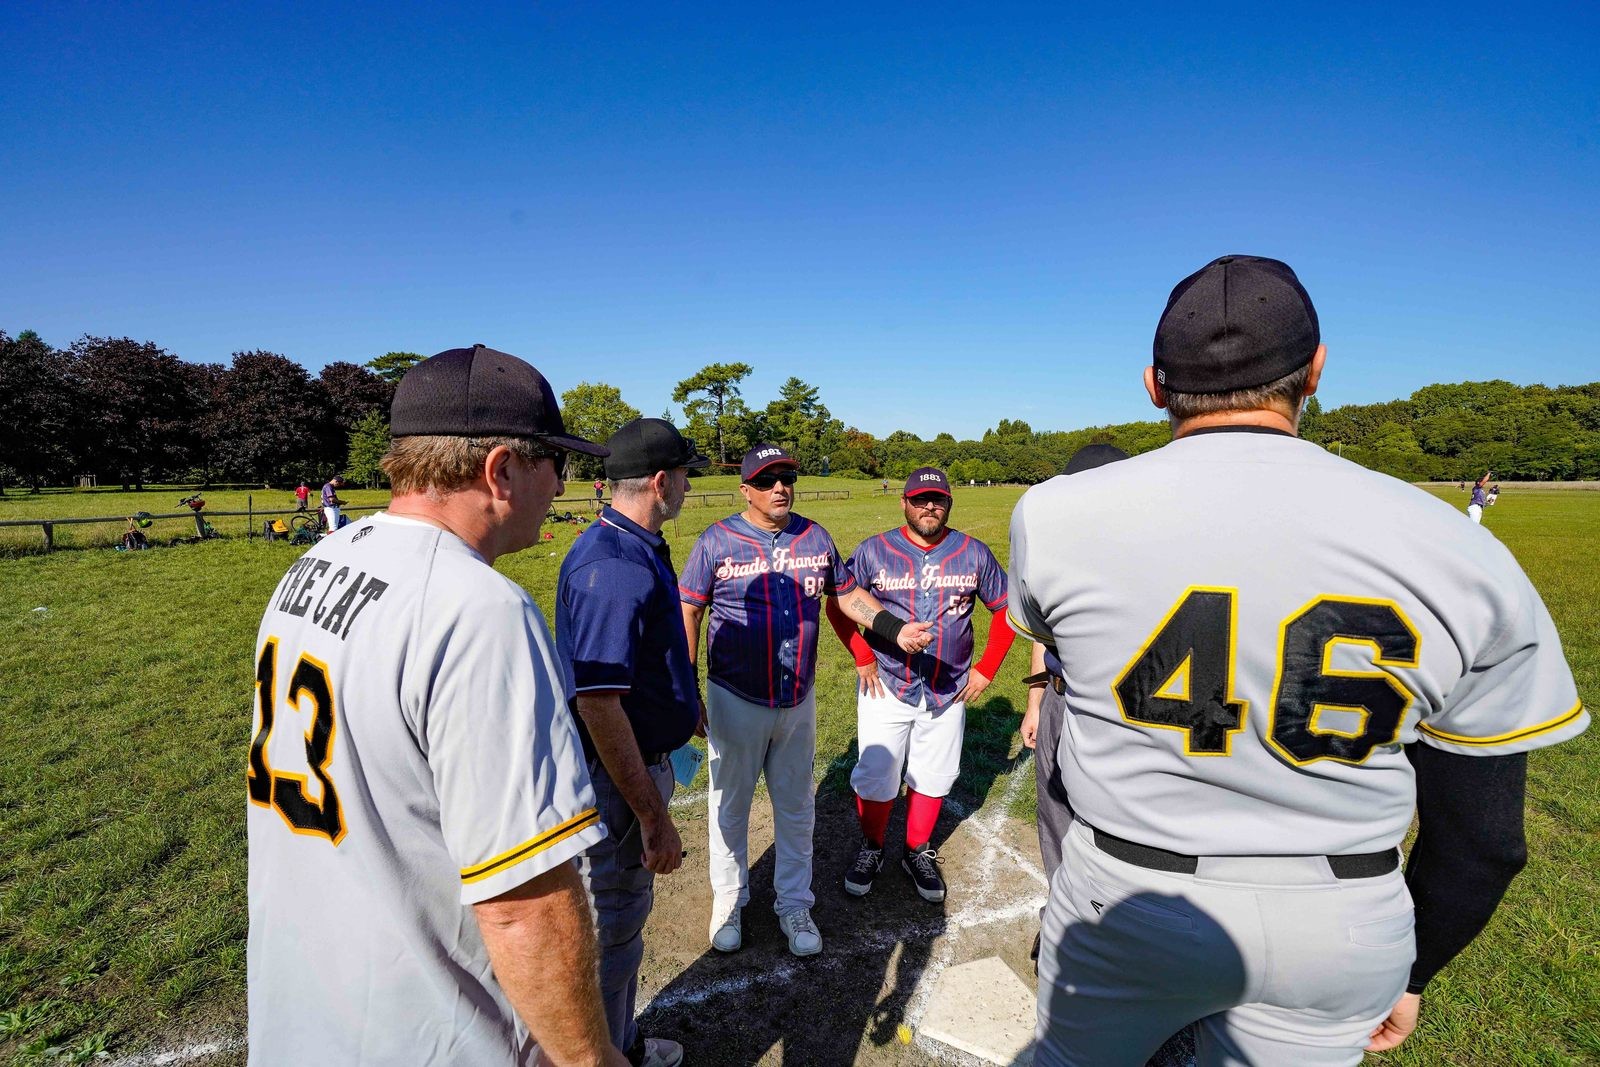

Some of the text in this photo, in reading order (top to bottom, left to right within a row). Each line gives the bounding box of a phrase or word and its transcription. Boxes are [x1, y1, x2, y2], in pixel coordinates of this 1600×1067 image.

[756, 448, 782, 460] 1883
[920, 473, 942, 482] 1883
[716, 547, 830, 581] Stade Françai
[873, 569, 918, 592] Stade
[273, 557, 389, 641] THE CAT
[1112, 586, 1420, 766] 46
[247, 636, 348, 847] 13
